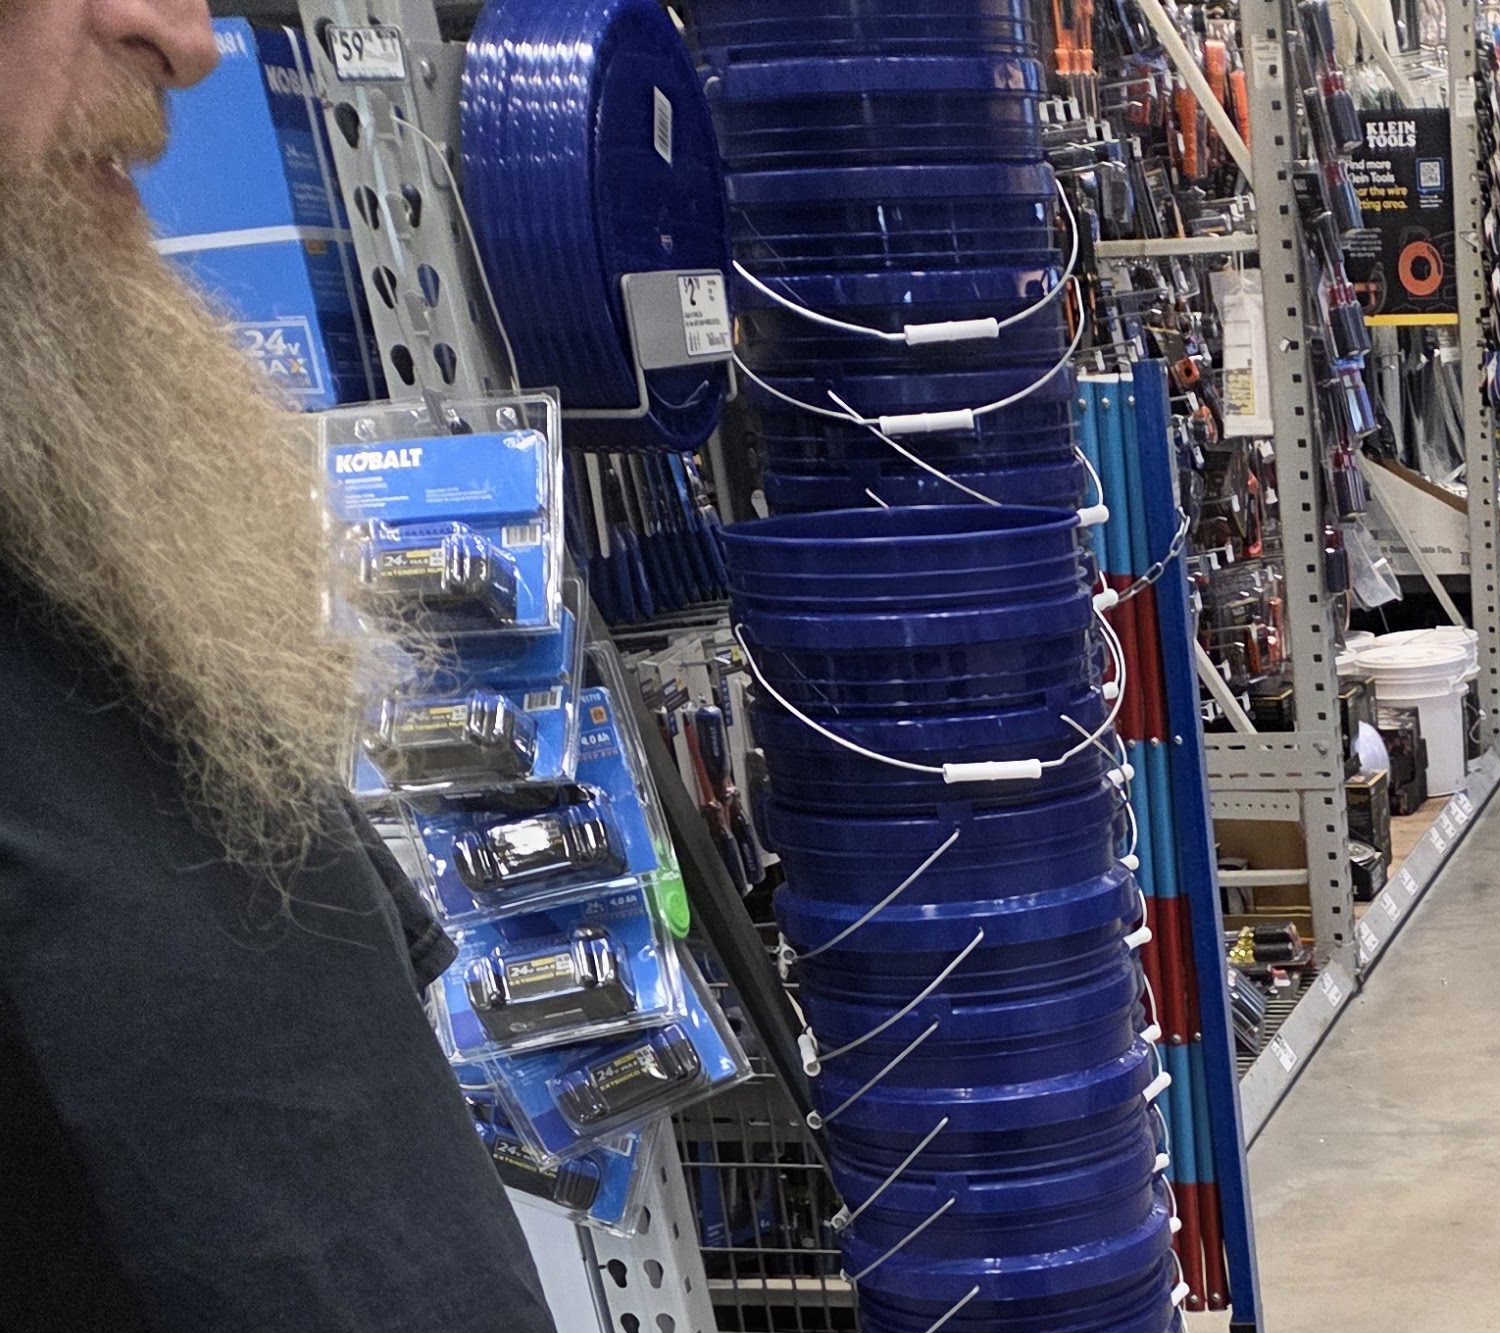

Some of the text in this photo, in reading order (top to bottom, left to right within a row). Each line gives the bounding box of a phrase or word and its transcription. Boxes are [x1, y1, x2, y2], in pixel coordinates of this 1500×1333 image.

[1366, 121, 1416, 135] KLEIN
[1366, 134, 1417, 148] TOOLS
[1348, 159, 1365, 170] ind
[1370, 171, 1395, 183] Tools
[1369, 185, 1385, 196] the
[1386, 184, 1408, 196] wire
[335, 447, 423, 474] KOBALT
